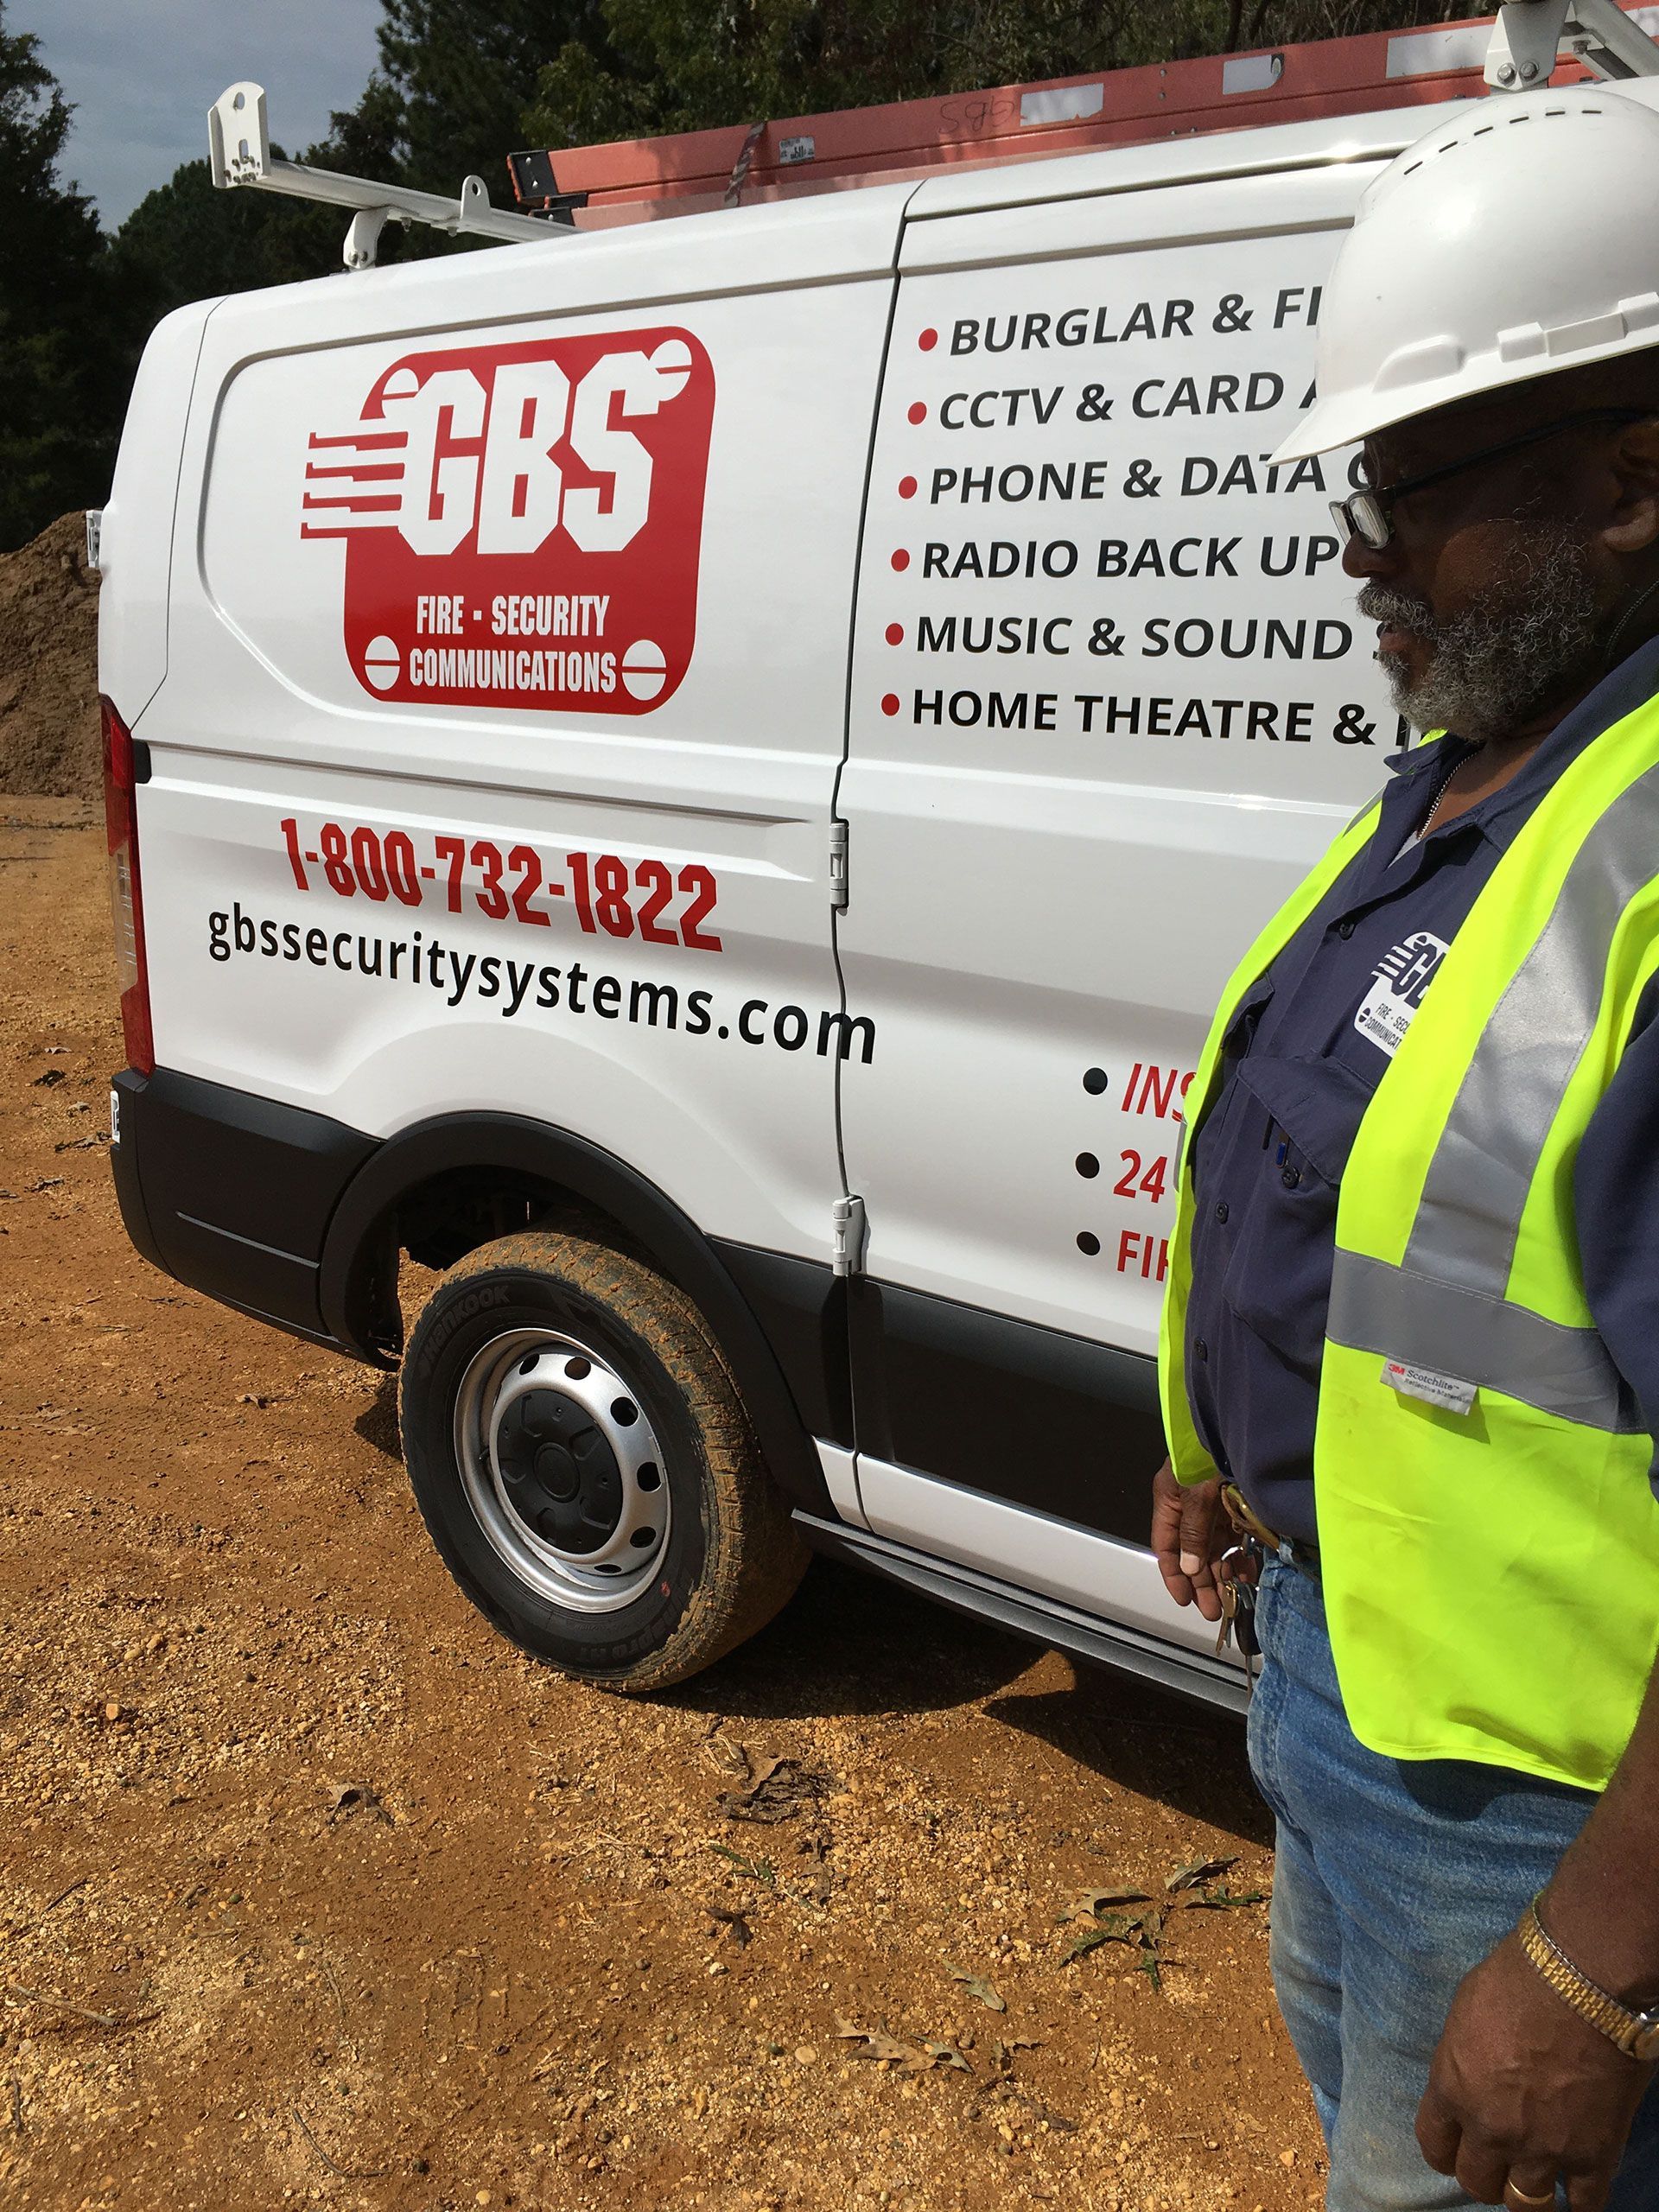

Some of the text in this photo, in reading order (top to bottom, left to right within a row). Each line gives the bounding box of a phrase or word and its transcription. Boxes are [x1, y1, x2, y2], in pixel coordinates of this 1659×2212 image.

[950, 299, 1194, 356] BURGLAR
[1212, 294, 1254, 334] &
[939, 385, 1065, 430] CCTV
[1076, 383, 1115, 423] &
[1132, 372, 1284, 418] CARD
[397, 349, 655, 556] GBS
[930, 461, 1108, 505] PHONE
[1122, 459, 1165, 499] &
[1180, 449, 1327, 497] DATA
[923, 535, 1339, 579] RADIO BACK UP
[416, 594, 463, 634] FIRE
[491, 594, 610, 637] SECURITY
[917, 616, 1073, 656] MUSIC
[1087, 617, 1126, 657] &
[1141, 618, 1353, 660] SOUND
[410, 648, 617, 693] COMMUNICATIONS
[913, 689, 1058, 731] HOME
[1074, 695, 1315, 743] THEATRE
[1332, 703, 1377, 746] &
[280, 817, 723, 952] 1-800-732-1822
[208, 902, 877, 1065] gbssecuritysystems.com
[1376, 1002, 1392, 1020] FIRE
[1113, 1148, 1167, 1203] 24
[1389, 1363, 1406, 1376] 3M
